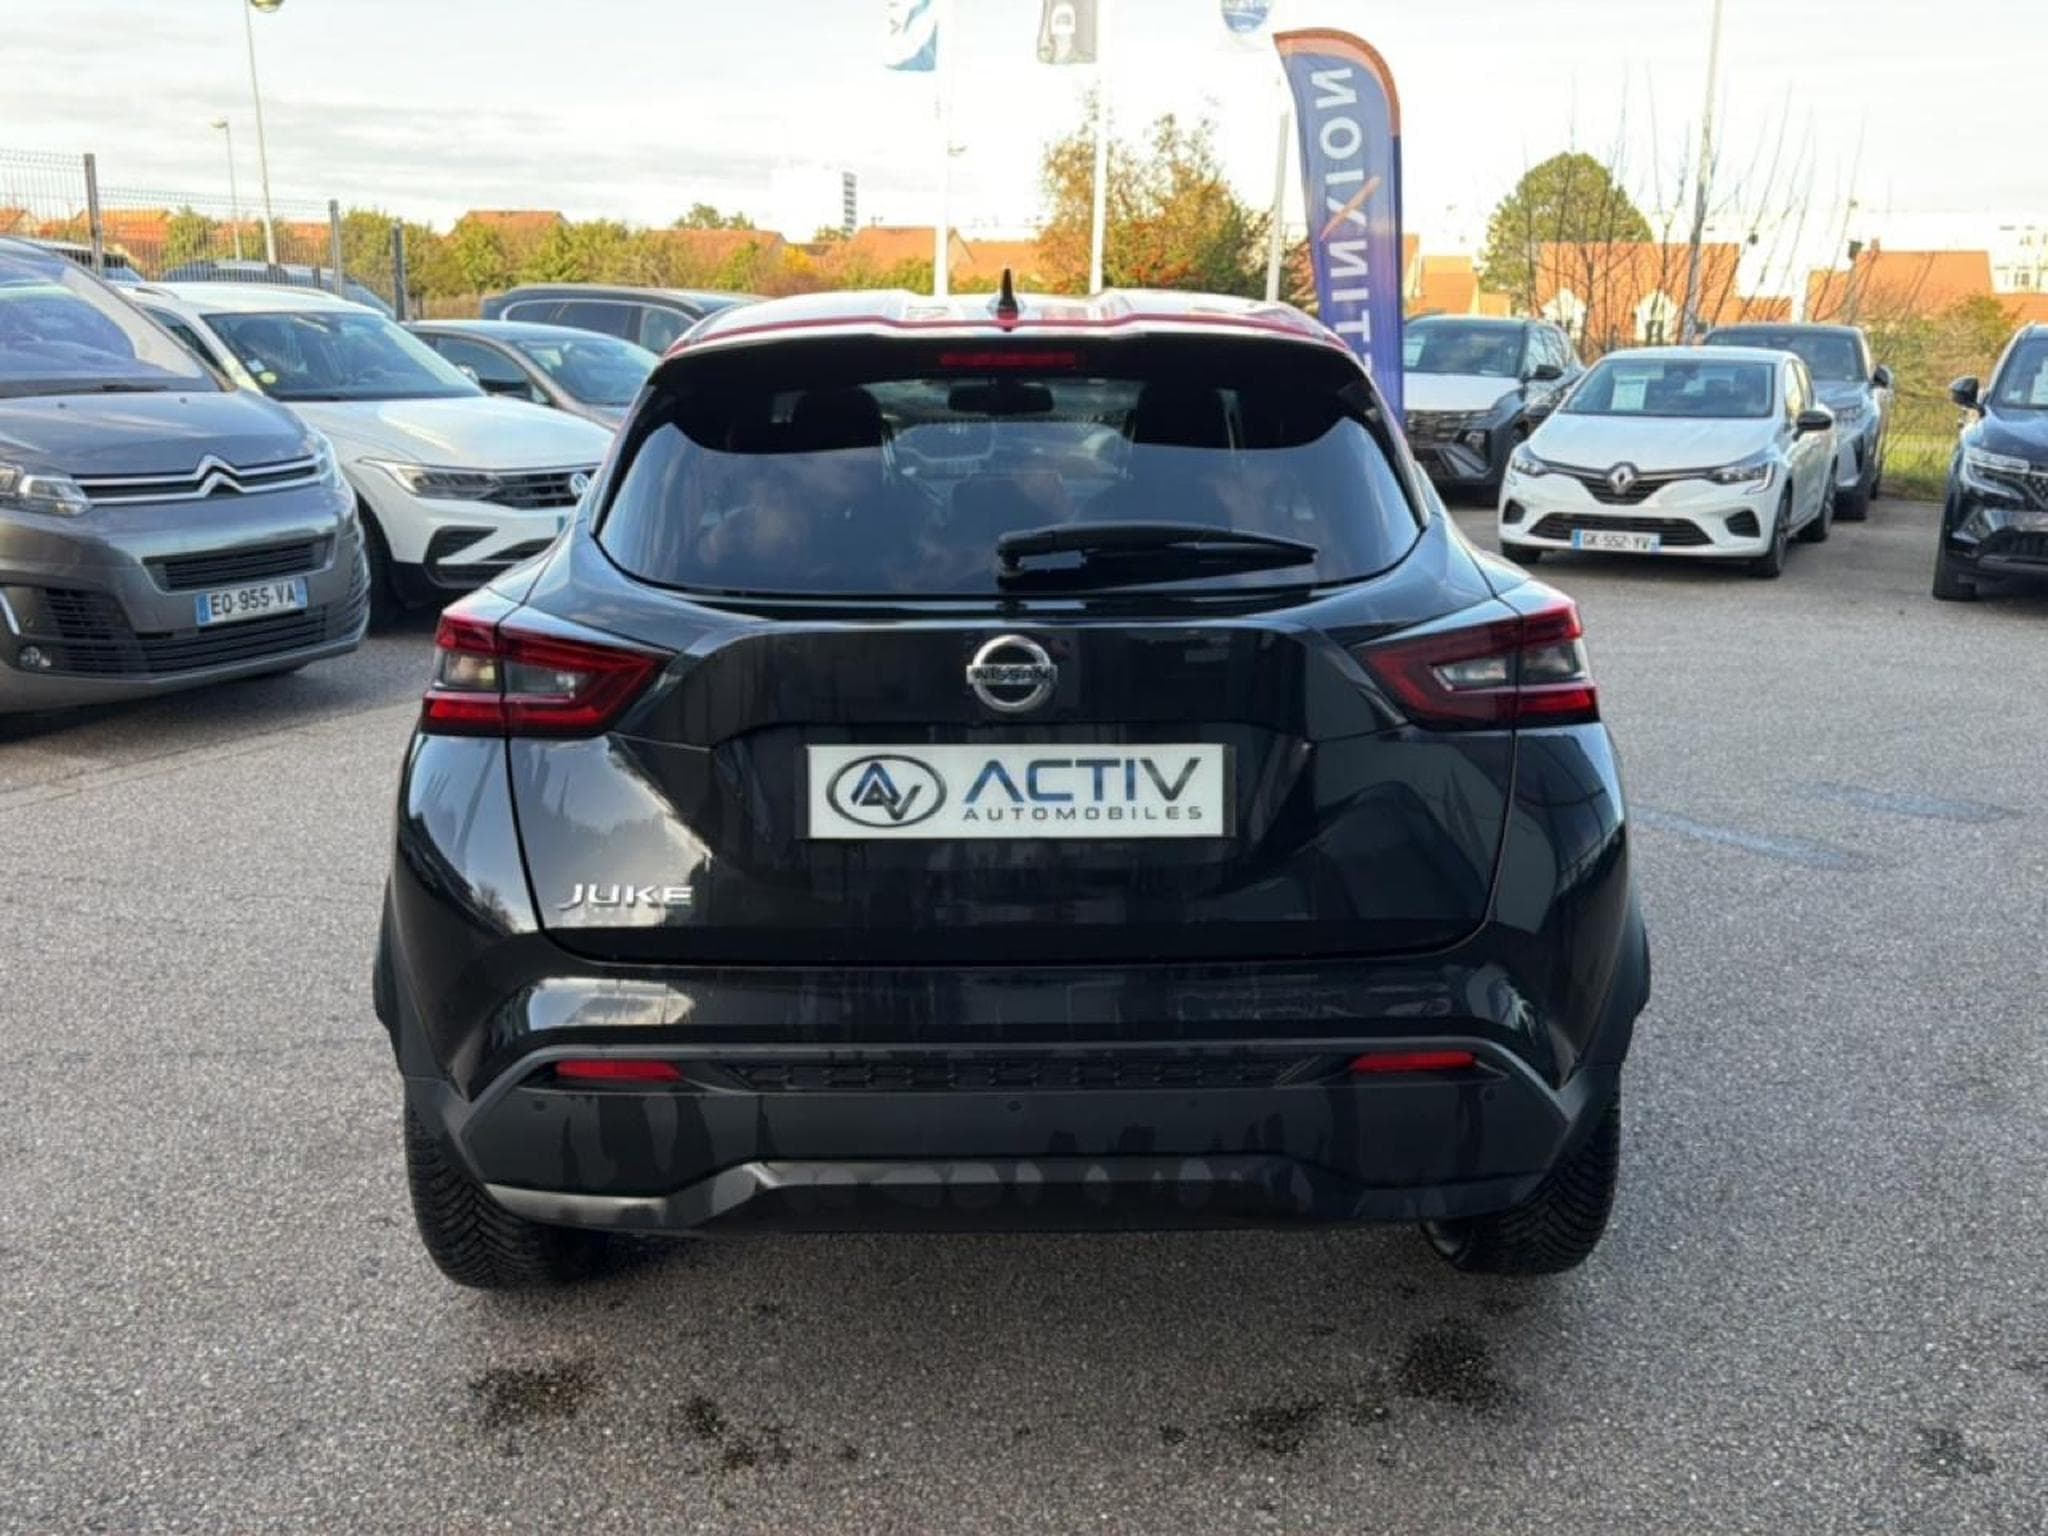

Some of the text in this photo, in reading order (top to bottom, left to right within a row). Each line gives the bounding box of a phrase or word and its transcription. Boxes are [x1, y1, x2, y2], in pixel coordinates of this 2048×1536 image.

[964, 757, 1201, 803] ACTIV
[963, 806, 1203, 821] AUTOMOBILES
[556, 883, 694, 910] JUKE
